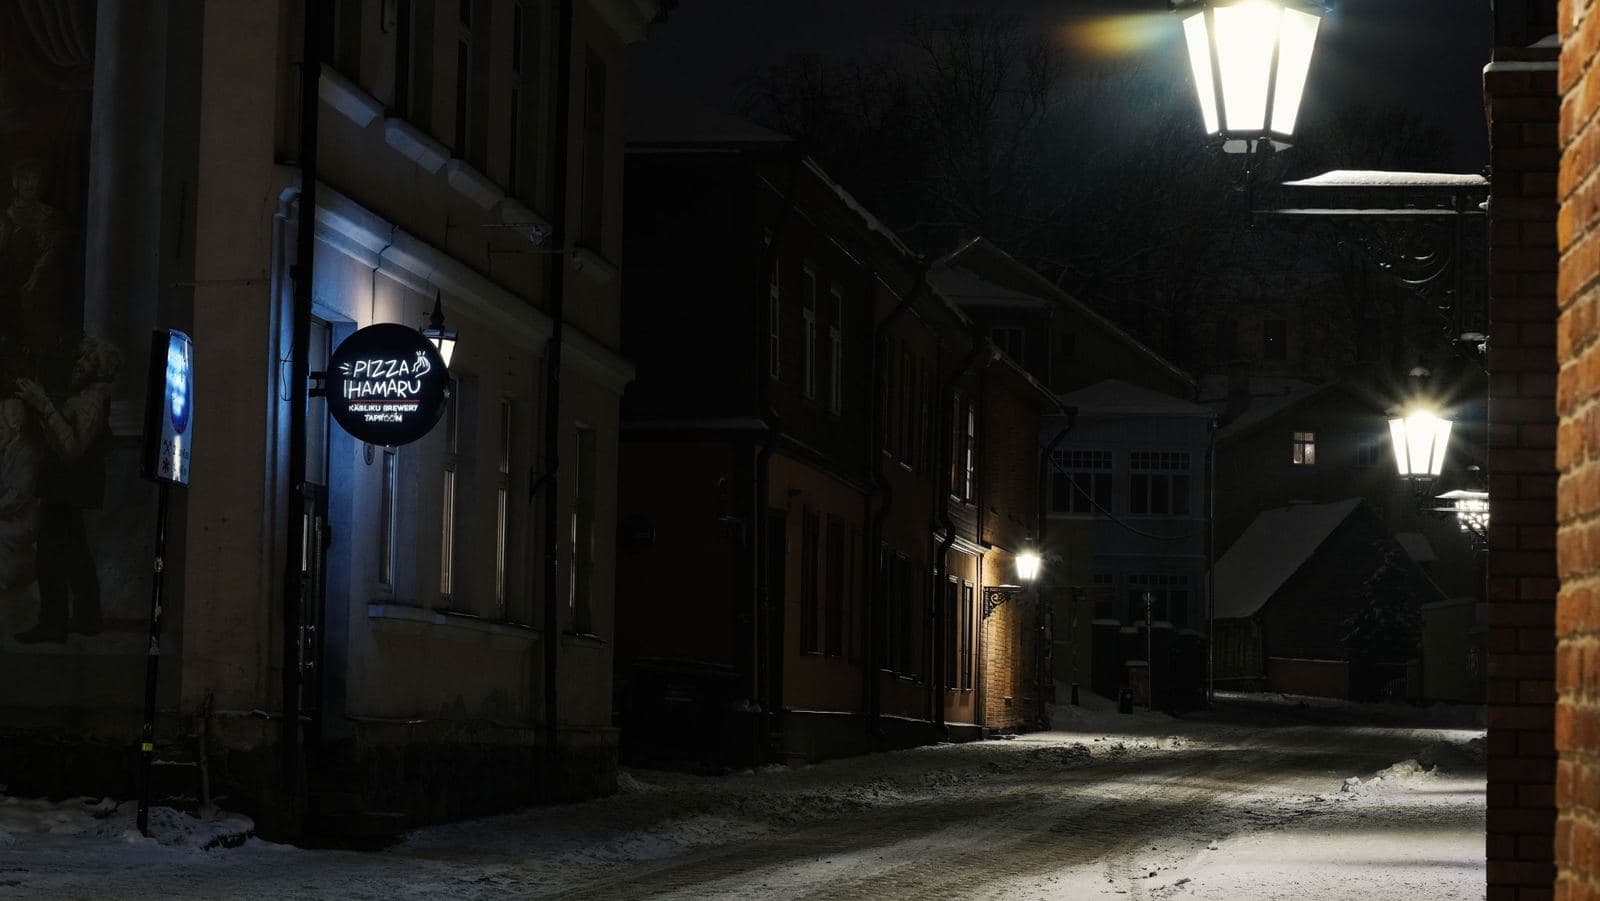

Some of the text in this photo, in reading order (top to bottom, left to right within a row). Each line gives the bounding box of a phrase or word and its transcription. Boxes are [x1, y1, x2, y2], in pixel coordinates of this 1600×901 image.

[353, 359, 409, 378] PIZZA
[343, 379, 421, 399] IHAMARU
[383, 404, 418, 412] BREWERY
